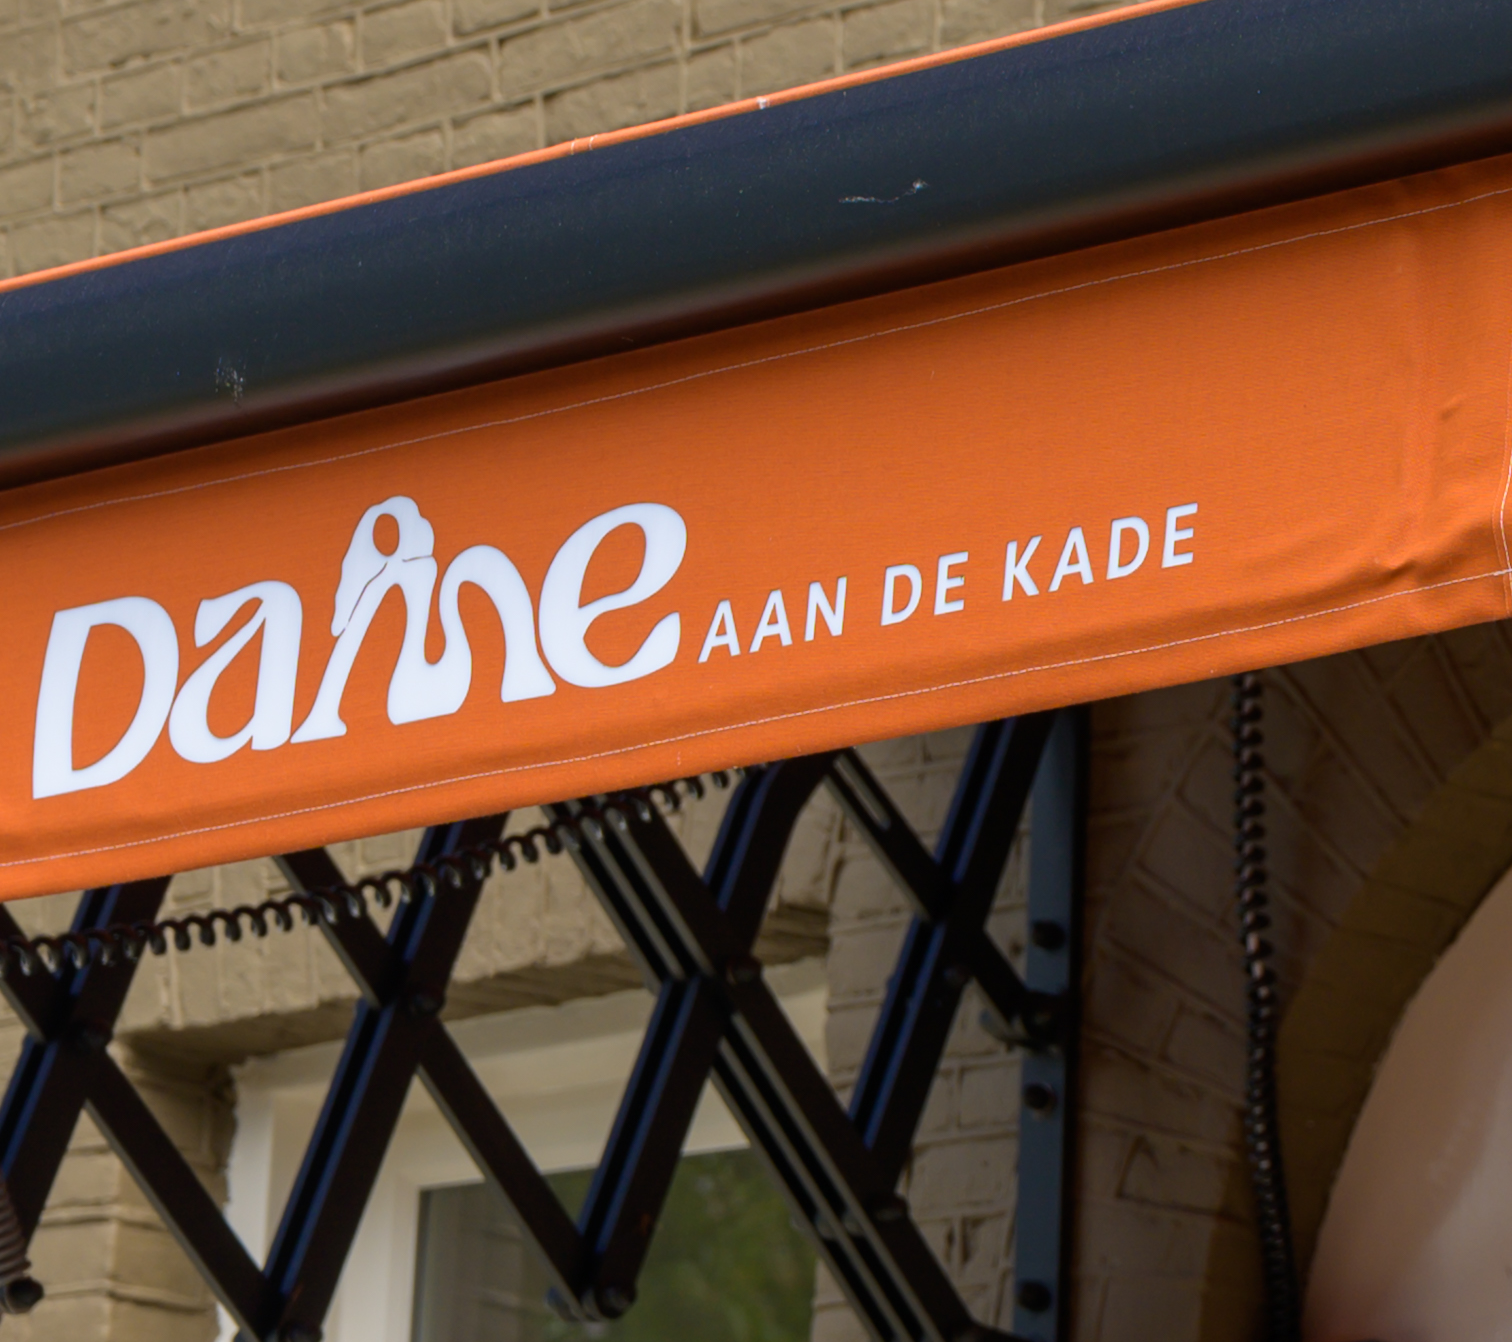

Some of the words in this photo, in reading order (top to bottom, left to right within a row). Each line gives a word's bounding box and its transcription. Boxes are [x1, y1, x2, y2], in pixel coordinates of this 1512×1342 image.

[697, 576, 847, 664] AAN
[880, 551, 969, 627] DE
[1001, 502, 1199, 602] KADE
